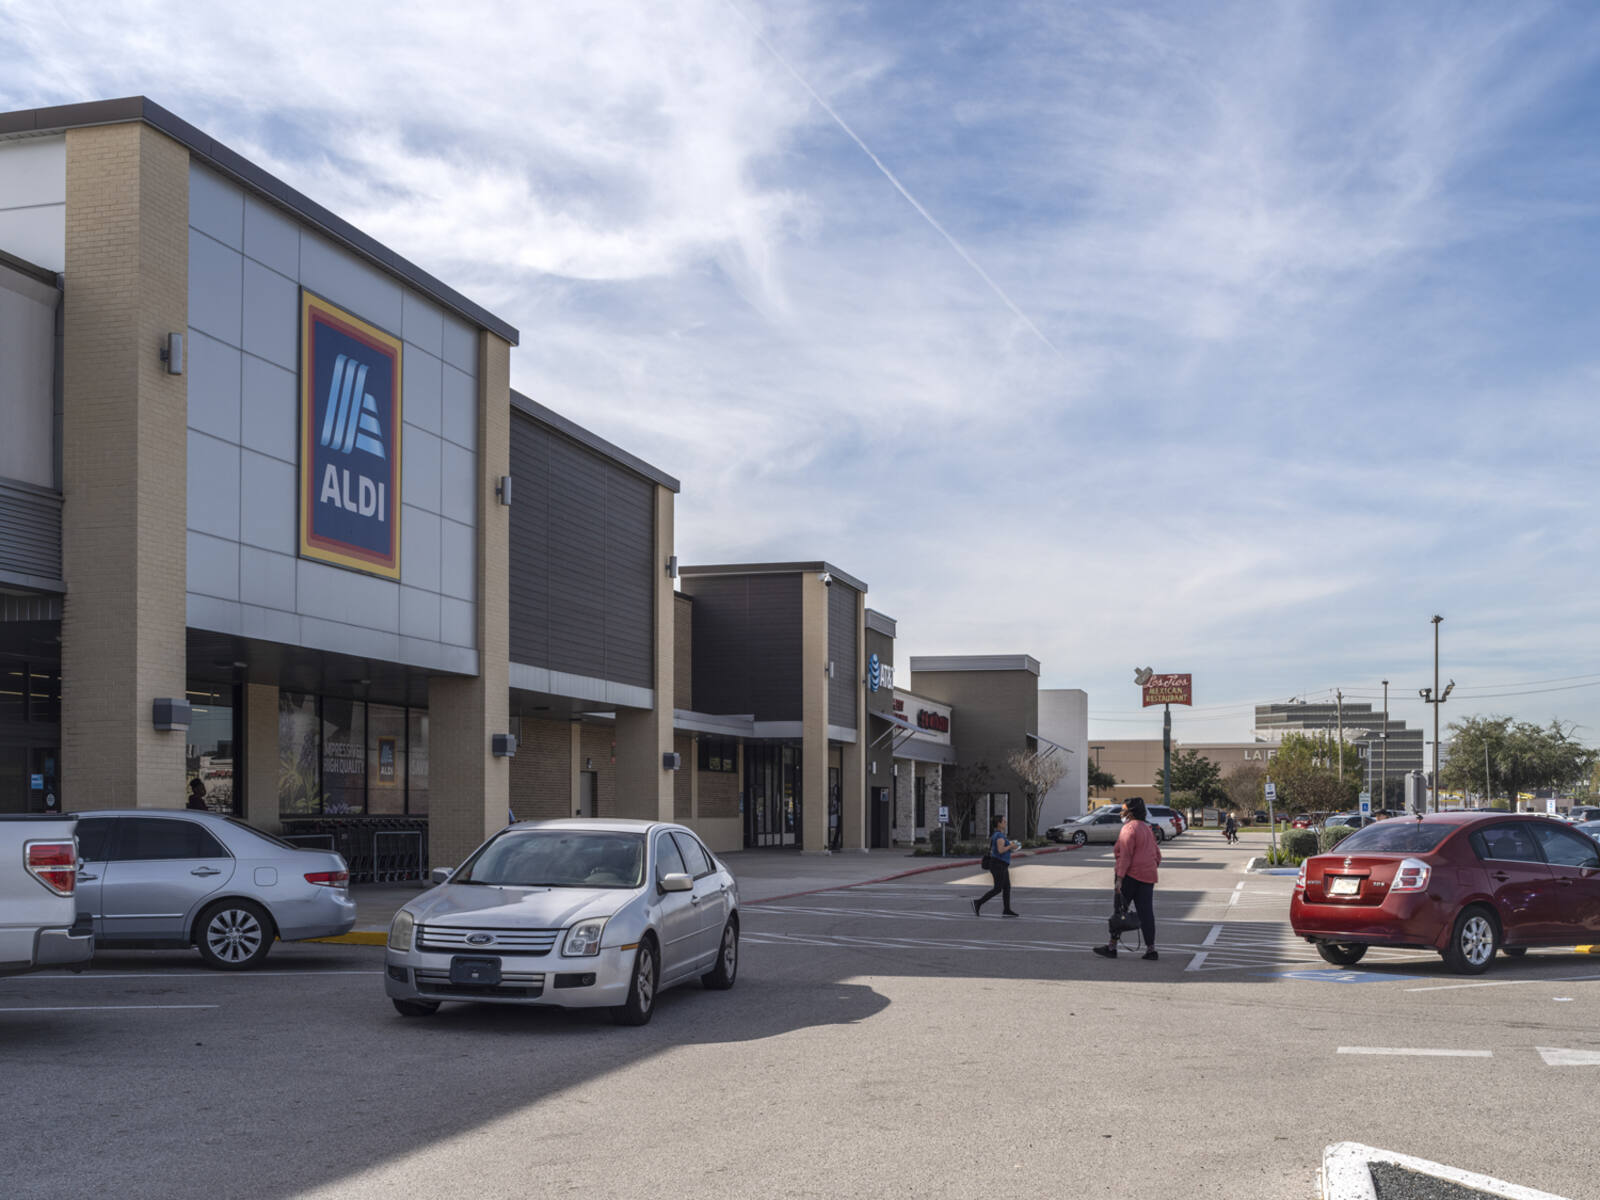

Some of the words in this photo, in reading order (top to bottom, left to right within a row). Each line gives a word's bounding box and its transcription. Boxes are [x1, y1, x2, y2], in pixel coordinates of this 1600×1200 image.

[320, 463, 385, 522] ALDI
[1144, 675, 1163, 687] Los
[1146, 694, 1188, 702] RESTAURANT
[380, 766, 394, 775] ALDI
